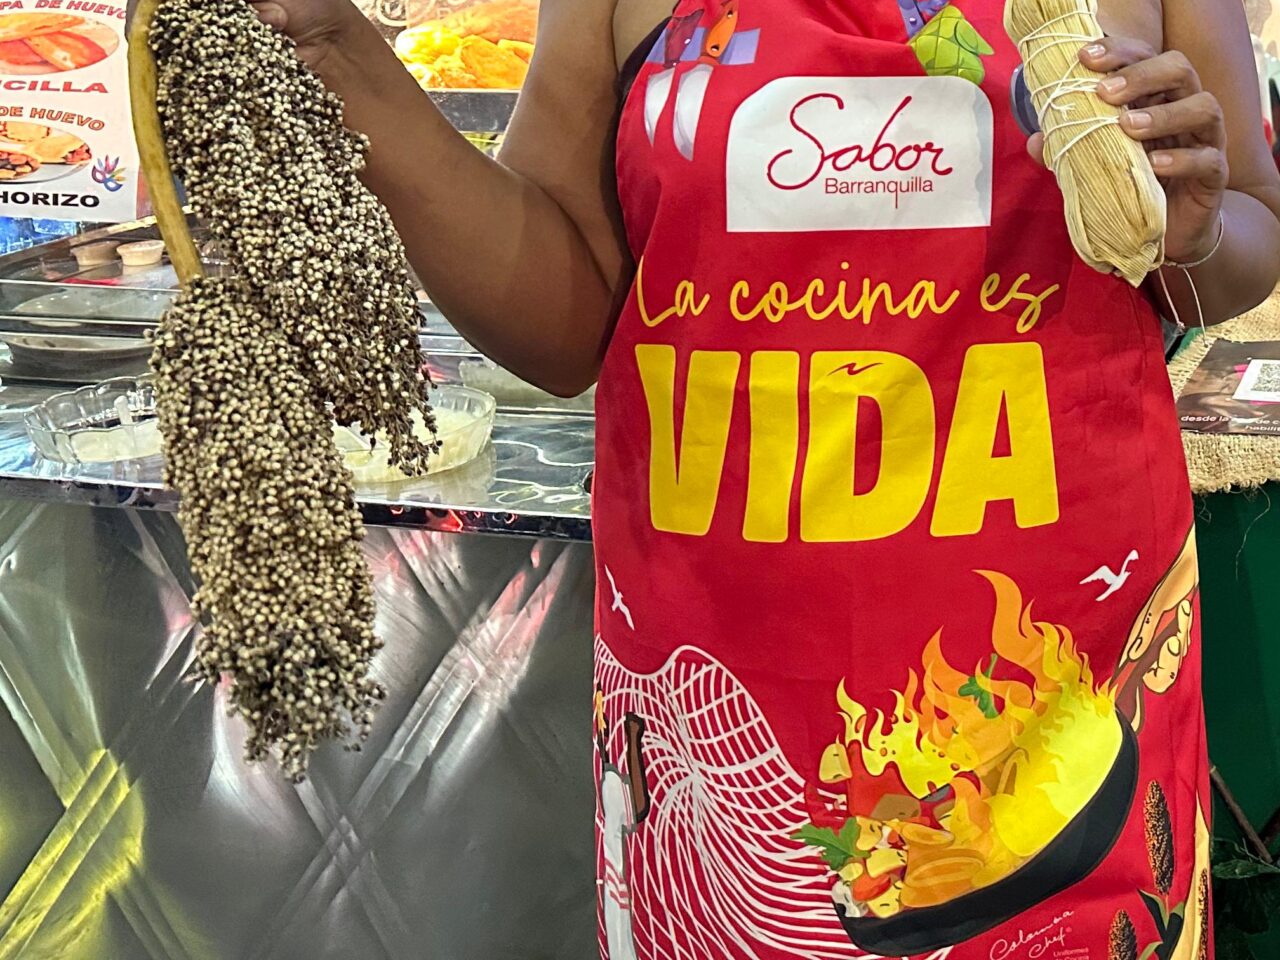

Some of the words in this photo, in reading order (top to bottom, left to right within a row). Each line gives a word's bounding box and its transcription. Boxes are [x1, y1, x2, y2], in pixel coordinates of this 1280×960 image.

[35, 0, 63, 9] DE
[66, 0, 126, 20] HUEVO
[0, 80, 109, 93] CILLA
[29, 107, 105, 131] HUEVO
[767, 93, 953, 191] Sabor
[824, 176, 933, 209] Barranquilla
[636, 255, 709, 327] La
[729, 261, 959, 324] cocina
[980, 270, 1059, 333] es
[1181, 414, 1217, 423] desde
[634, 342, 1059, 543] VIDA
